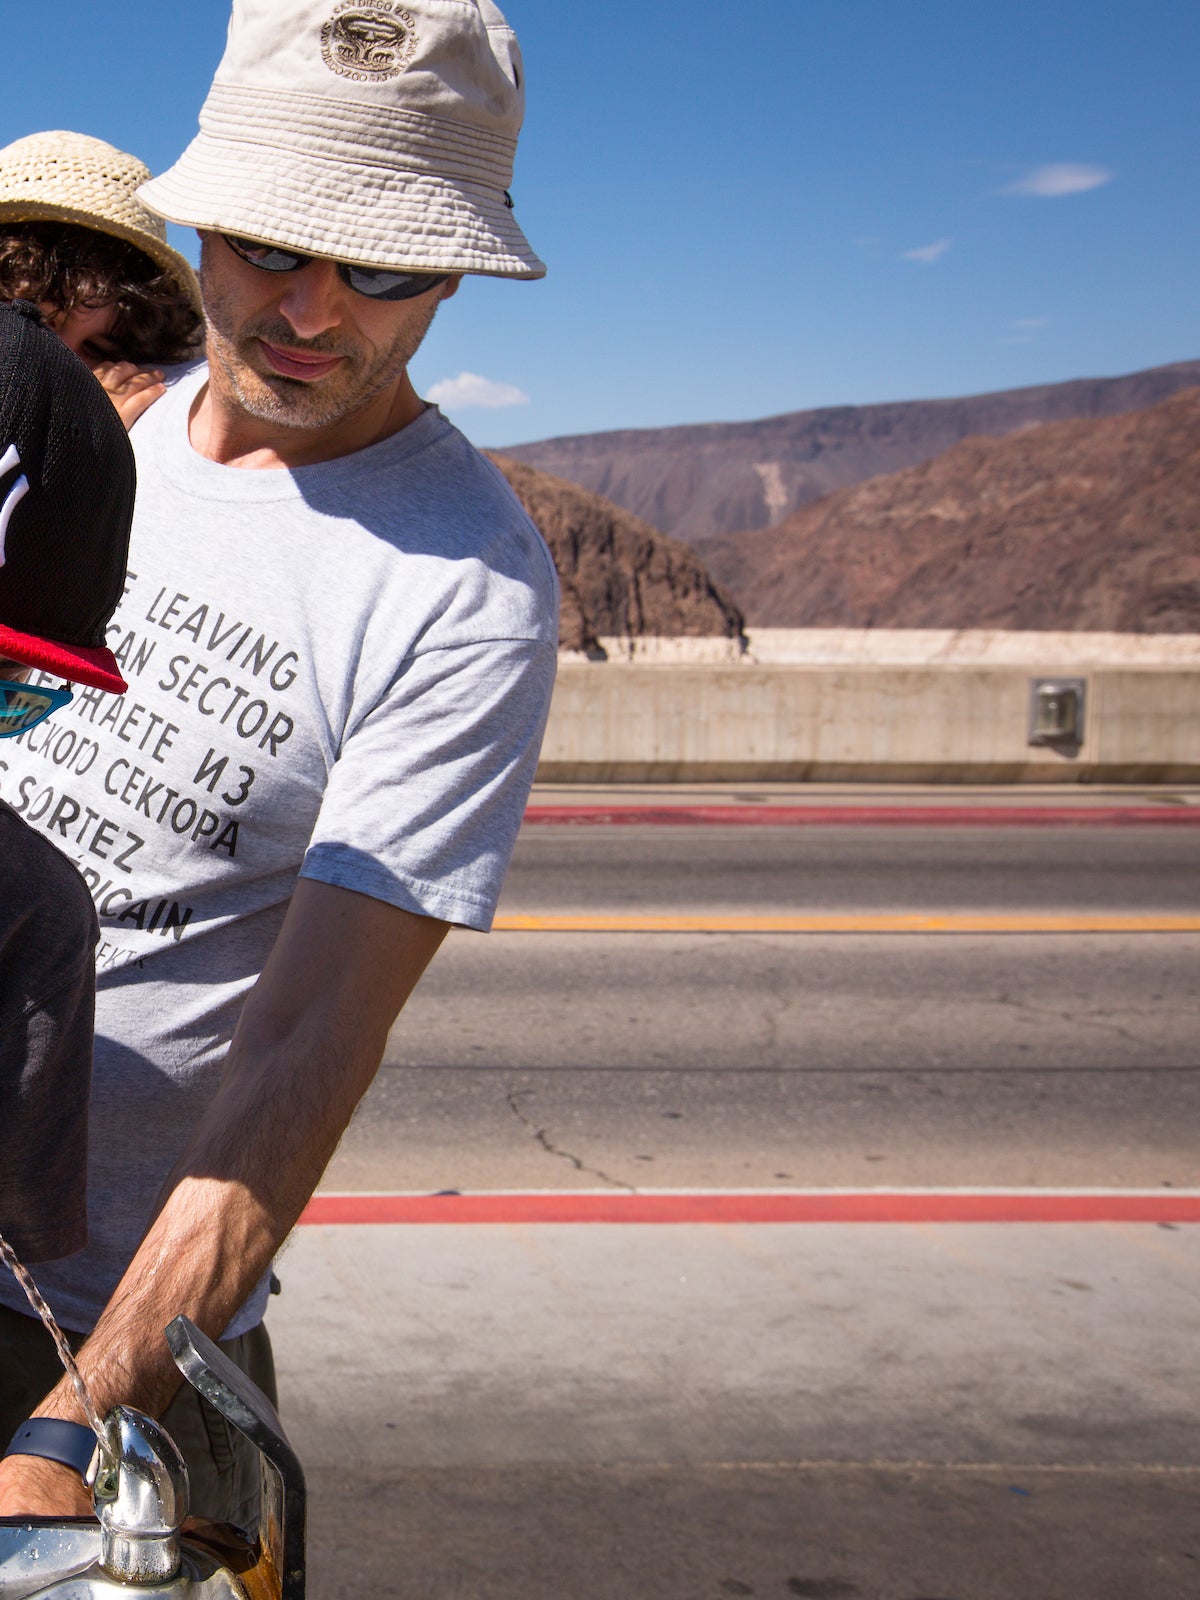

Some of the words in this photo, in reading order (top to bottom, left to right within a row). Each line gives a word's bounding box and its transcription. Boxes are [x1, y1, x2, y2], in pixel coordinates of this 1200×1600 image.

[357, 0, 392, 12] DIEGO
[394, 6, 416, 28] ZOO
[321, 47, 344, 75] DIEGO
[343, 70, 368, 82] ZOO
[145, 586, 299, 691] LEAVING
[159, 655, 295, 758] SECTOR
[9, 776, 145, 874] SORTEZ
[104, 759, 239, 857] СЕКТОРА
